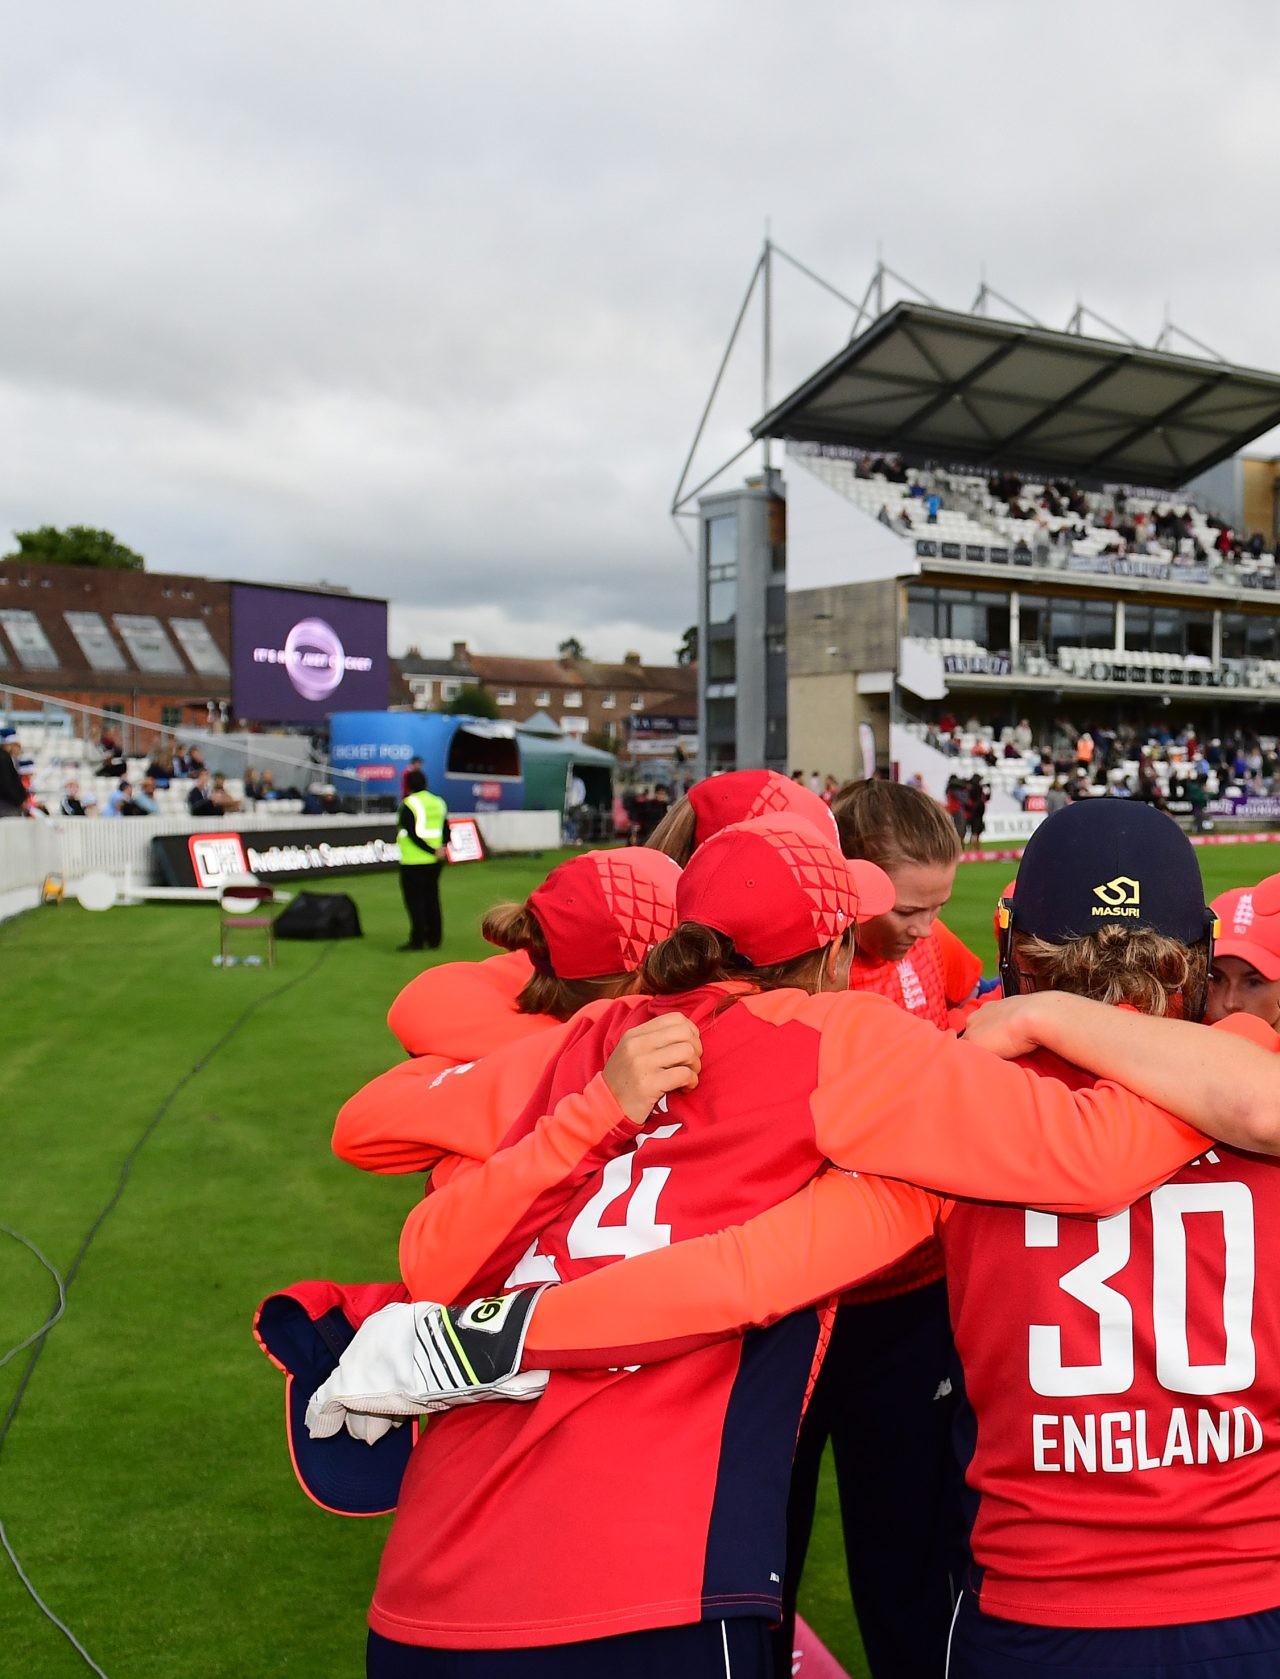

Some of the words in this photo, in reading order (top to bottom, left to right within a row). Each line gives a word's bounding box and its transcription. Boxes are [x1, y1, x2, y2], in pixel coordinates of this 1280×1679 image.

[1091, 906, 1140, 919] MASURI
[1024, 1181, 1257, 1397] 30
[1032, 1405, 1264, 1474] ENGLAND
